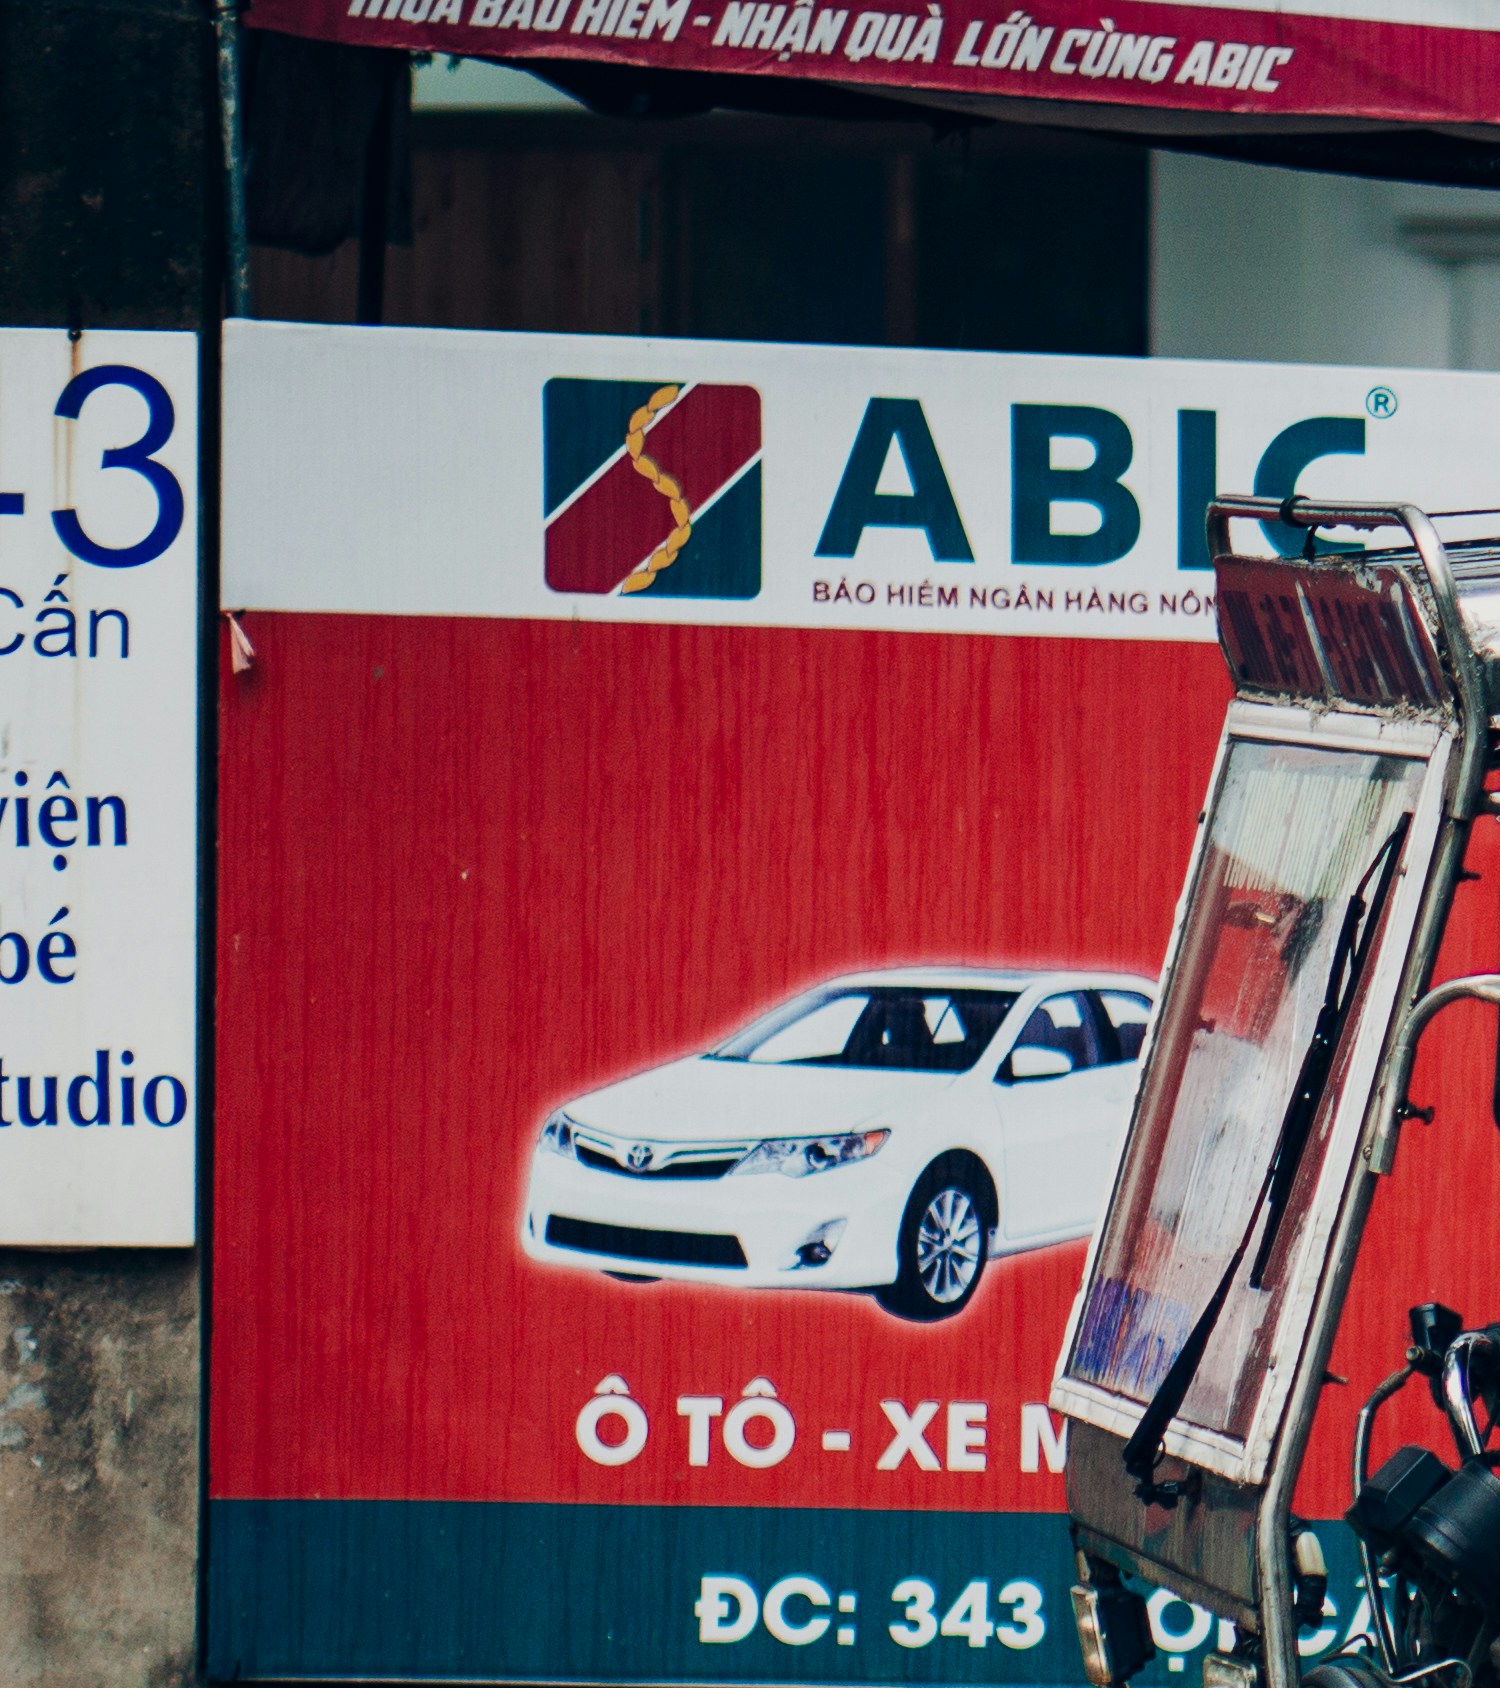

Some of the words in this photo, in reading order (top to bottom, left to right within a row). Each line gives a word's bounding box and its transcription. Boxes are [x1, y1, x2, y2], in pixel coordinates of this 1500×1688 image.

[953, 10, 1056, 73] LỚN
[1050, 17, 1178, 84] CÙNG
[1174, 41, 1294, 93] ABIC
[814, 397, 1366, 571] ABIC
[1064, 586, 1149, 615] HÀNG
[0, 770, 128, 872] iện
[575, 1373, 649, 1467] Ô
[676, 1375, 797, 1470] TÔ
[876, 1399, 988, 1473] XE
[694, 1576, 856, 1647] ĐC:
[888, 1579, 1046, 1650] 343
